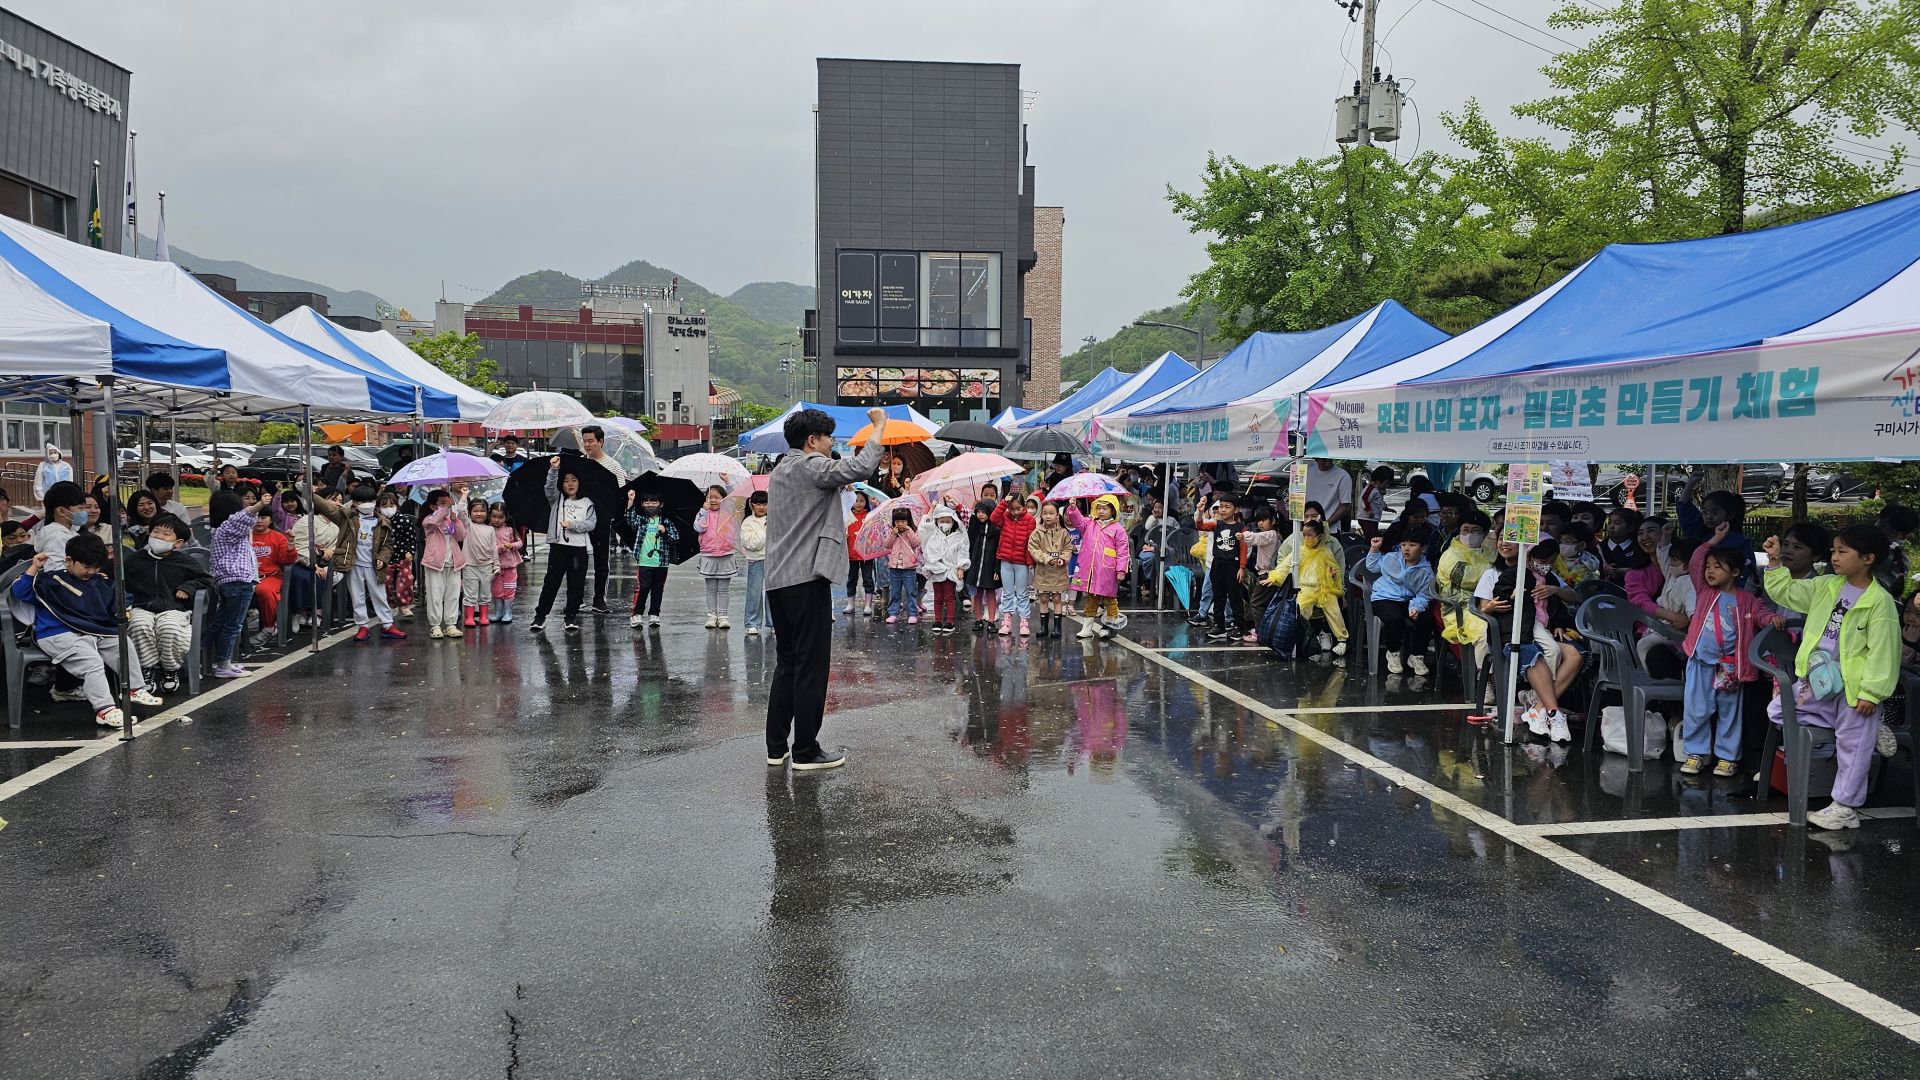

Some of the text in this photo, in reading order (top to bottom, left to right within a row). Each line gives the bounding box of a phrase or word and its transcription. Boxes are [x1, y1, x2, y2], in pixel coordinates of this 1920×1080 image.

[39, 59, 121, 121] 가족행복플라자
[842, 290, 872, 299] 이가자
[1893, 367, 1920, 390] 가
[1335, 401, 1365, 414] Welcome
[1377, 401, 1410, 433] 멋진
[1415, 399, 1452, 433] 나의
[1458, 395, 1501, 432] 모자
[1617, 375, 1723, 426] 만들기
[1732, 366, 1820, 420] 체험
[1183, 420, 1209, 443] 만들기
[1210, 418, 1230, 441] 체험
[1340, 418, 1360, 432] 온가족
[1338, 435, 1363, 449] 놀이축제
